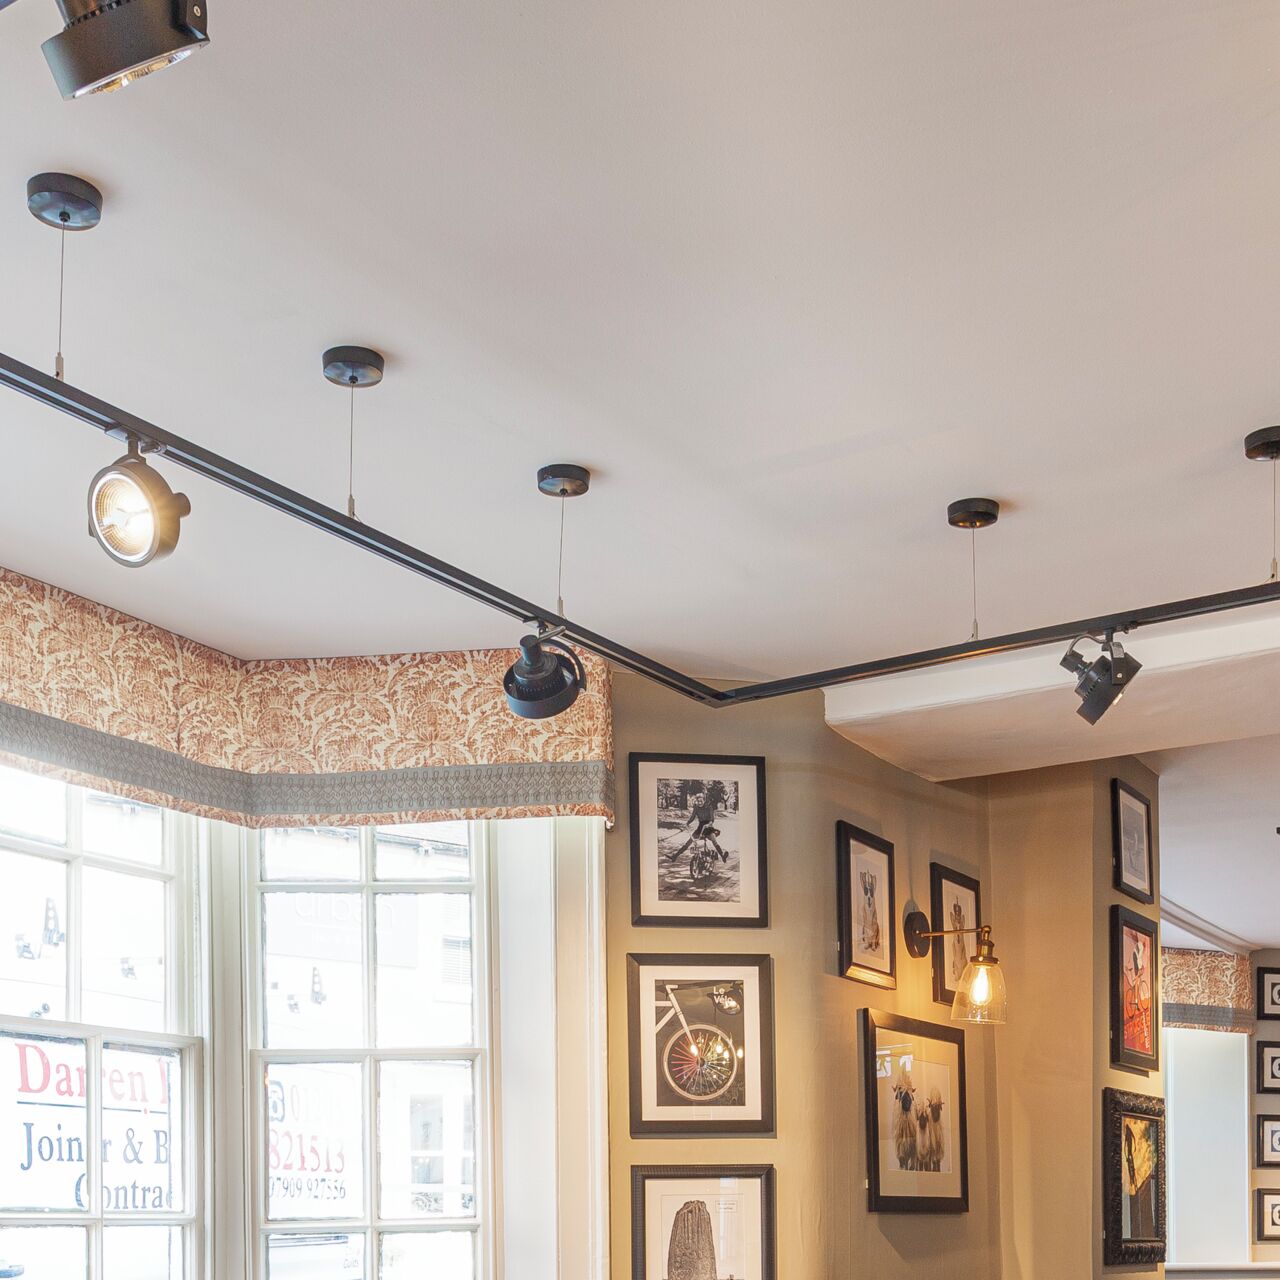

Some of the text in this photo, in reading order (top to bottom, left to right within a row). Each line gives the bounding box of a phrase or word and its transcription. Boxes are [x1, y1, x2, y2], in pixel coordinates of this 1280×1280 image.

[20, 1121, 112, 1171] Joinr
[122, 1127, 144, 1165] &
[269, 1127, 346, 1175] 821513
